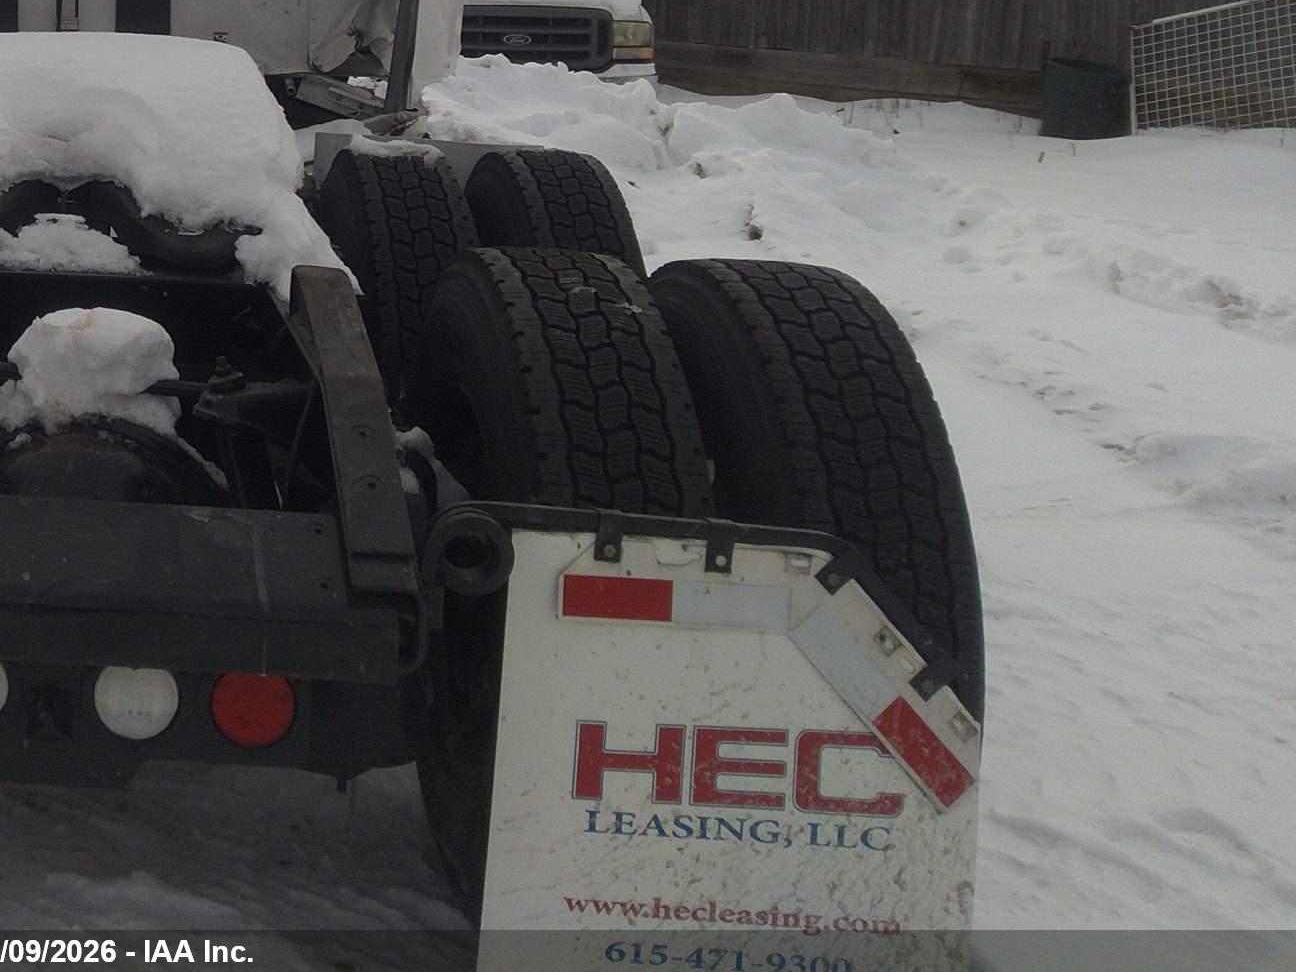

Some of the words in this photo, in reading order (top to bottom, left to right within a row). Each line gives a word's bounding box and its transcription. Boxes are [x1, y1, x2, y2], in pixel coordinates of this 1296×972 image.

[571, 719, 906, 818] HEC
[584, 809, 794, 849] LEASING,
[808, 824, 896, 851] LLC
[563, 895, 903, 937] www.hecleasing.com
[604, 941, 852, 972] 615-471-9300
